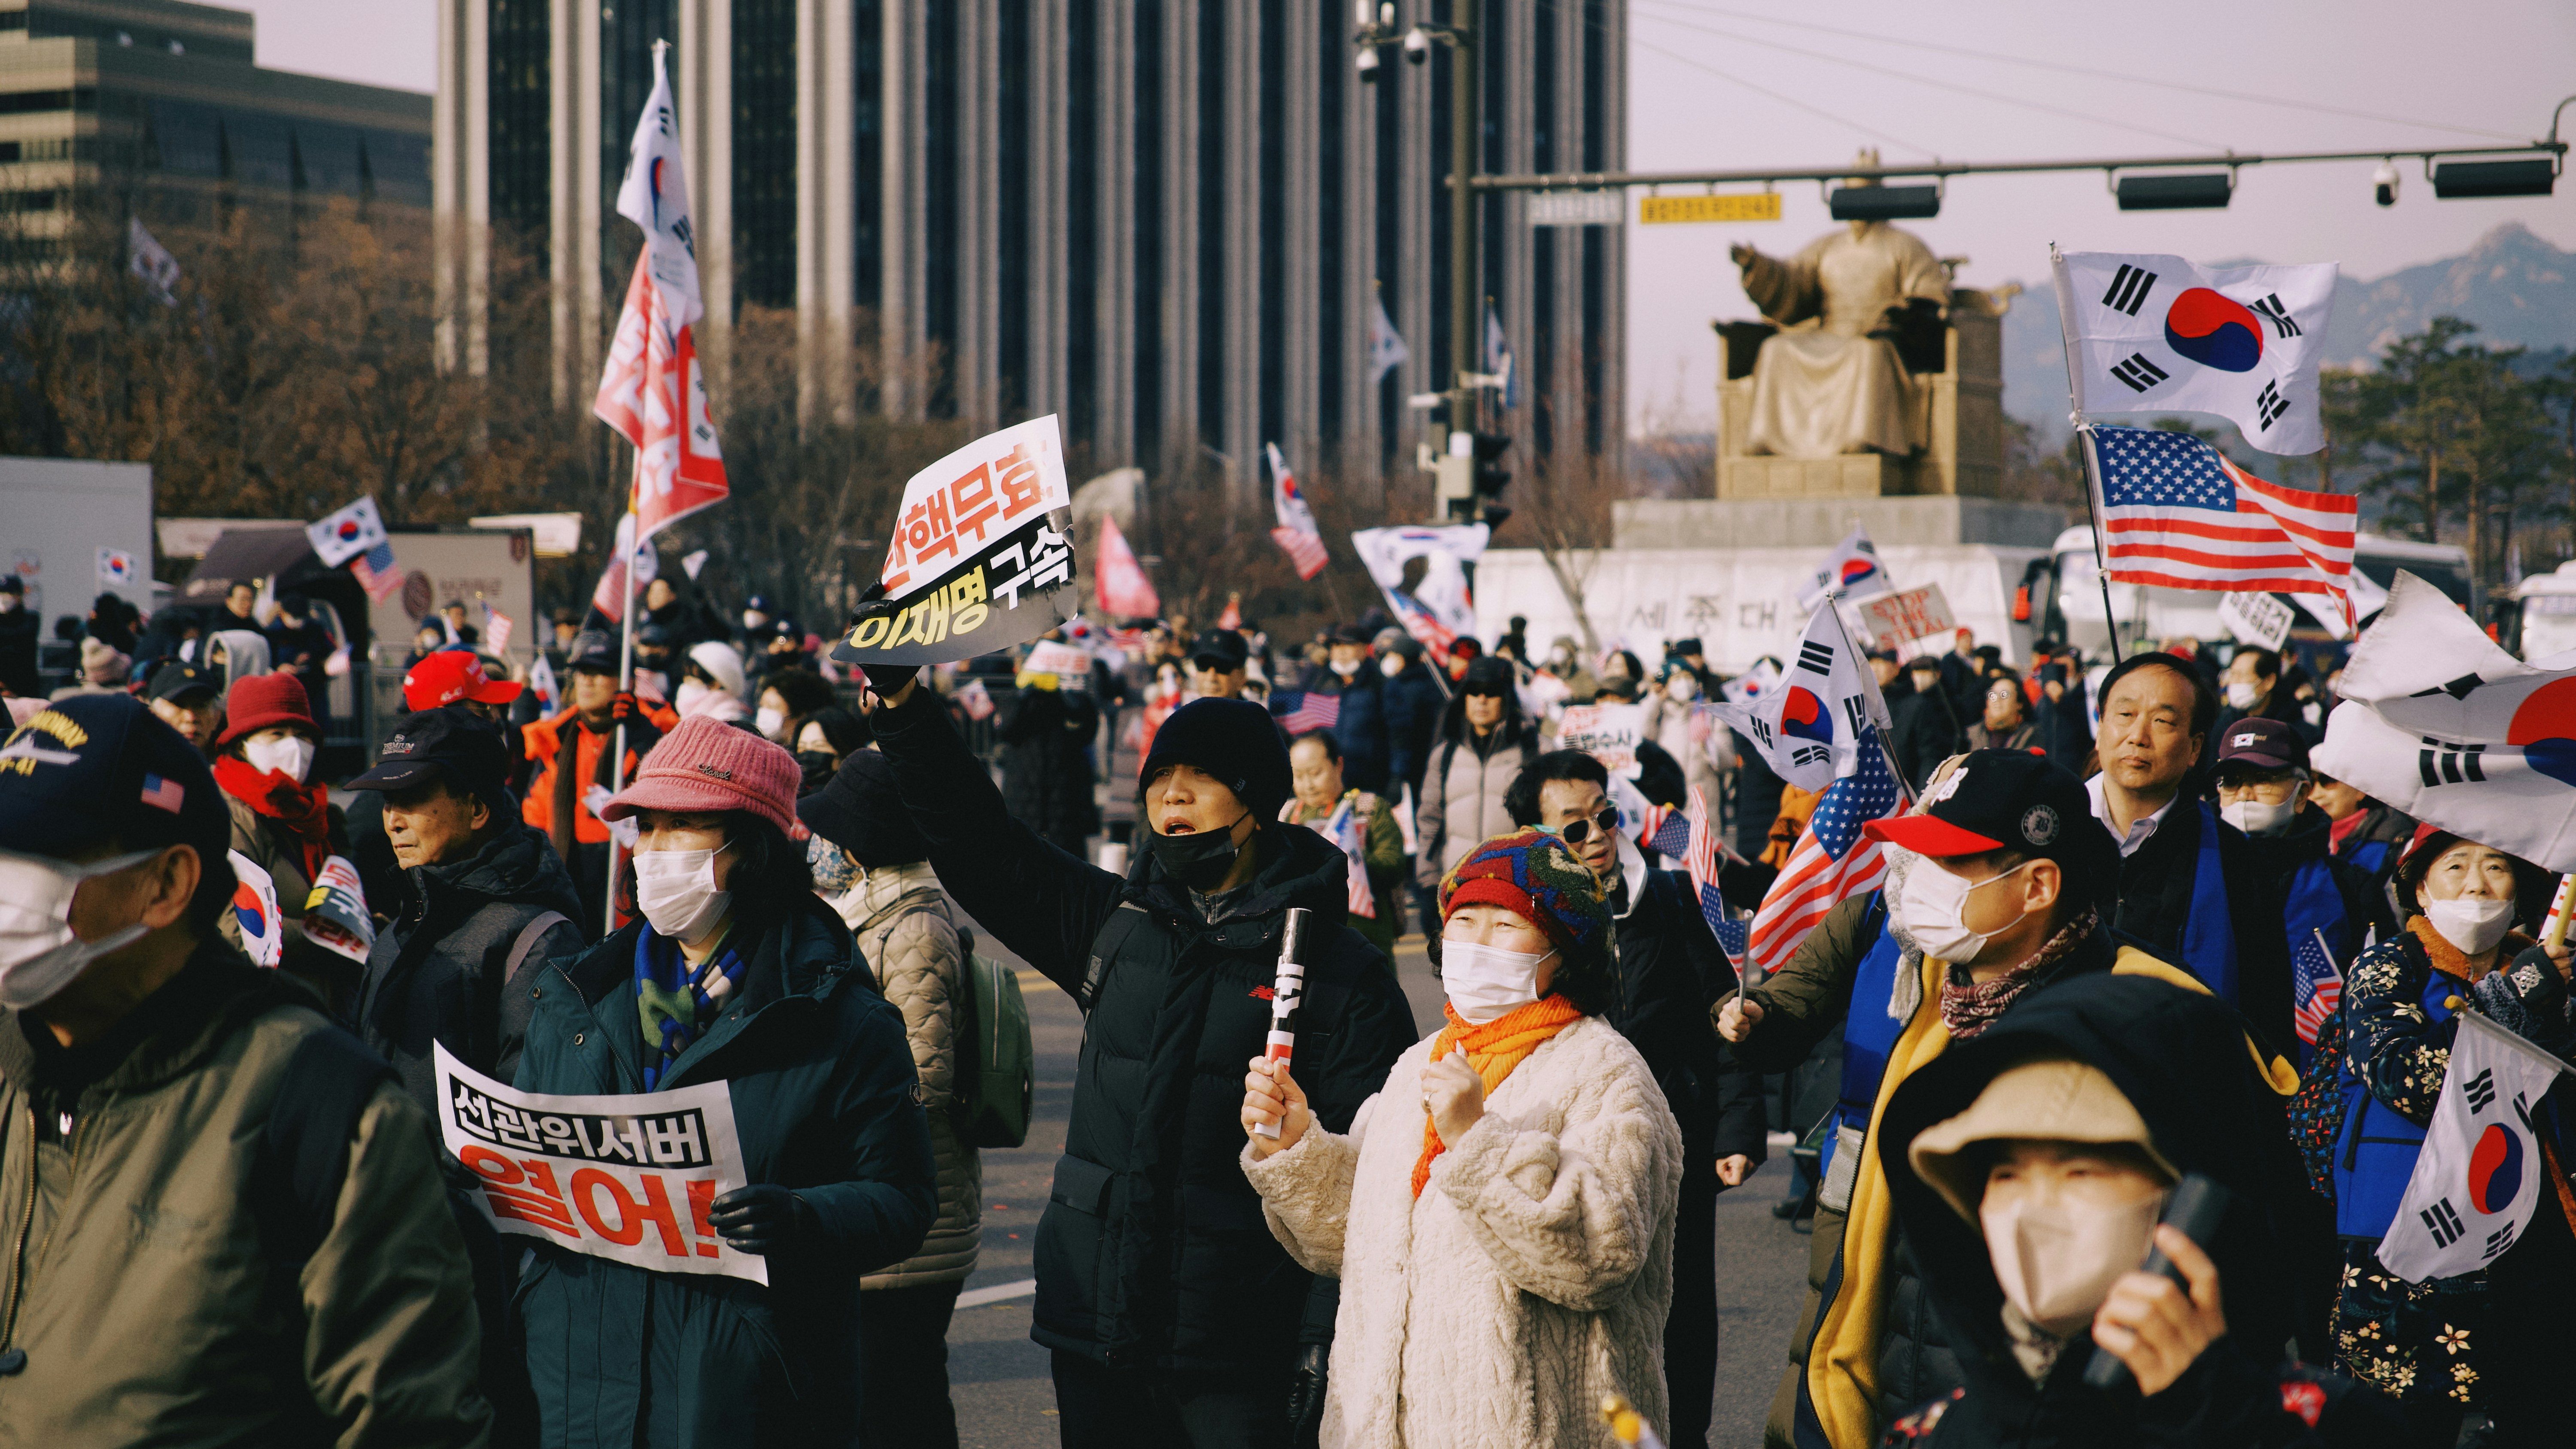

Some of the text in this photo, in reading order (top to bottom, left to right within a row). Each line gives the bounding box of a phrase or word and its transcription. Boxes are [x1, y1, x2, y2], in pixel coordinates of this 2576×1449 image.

[849, 525, 1069, 650] 이재명 구속
[1871, 590, 1929, 617] STOP
[1889, 610, 1925, 626] THE
[454, 1084, 704, 1164] 선관위서버
[459, 1145, 719, 1259] 열어!
